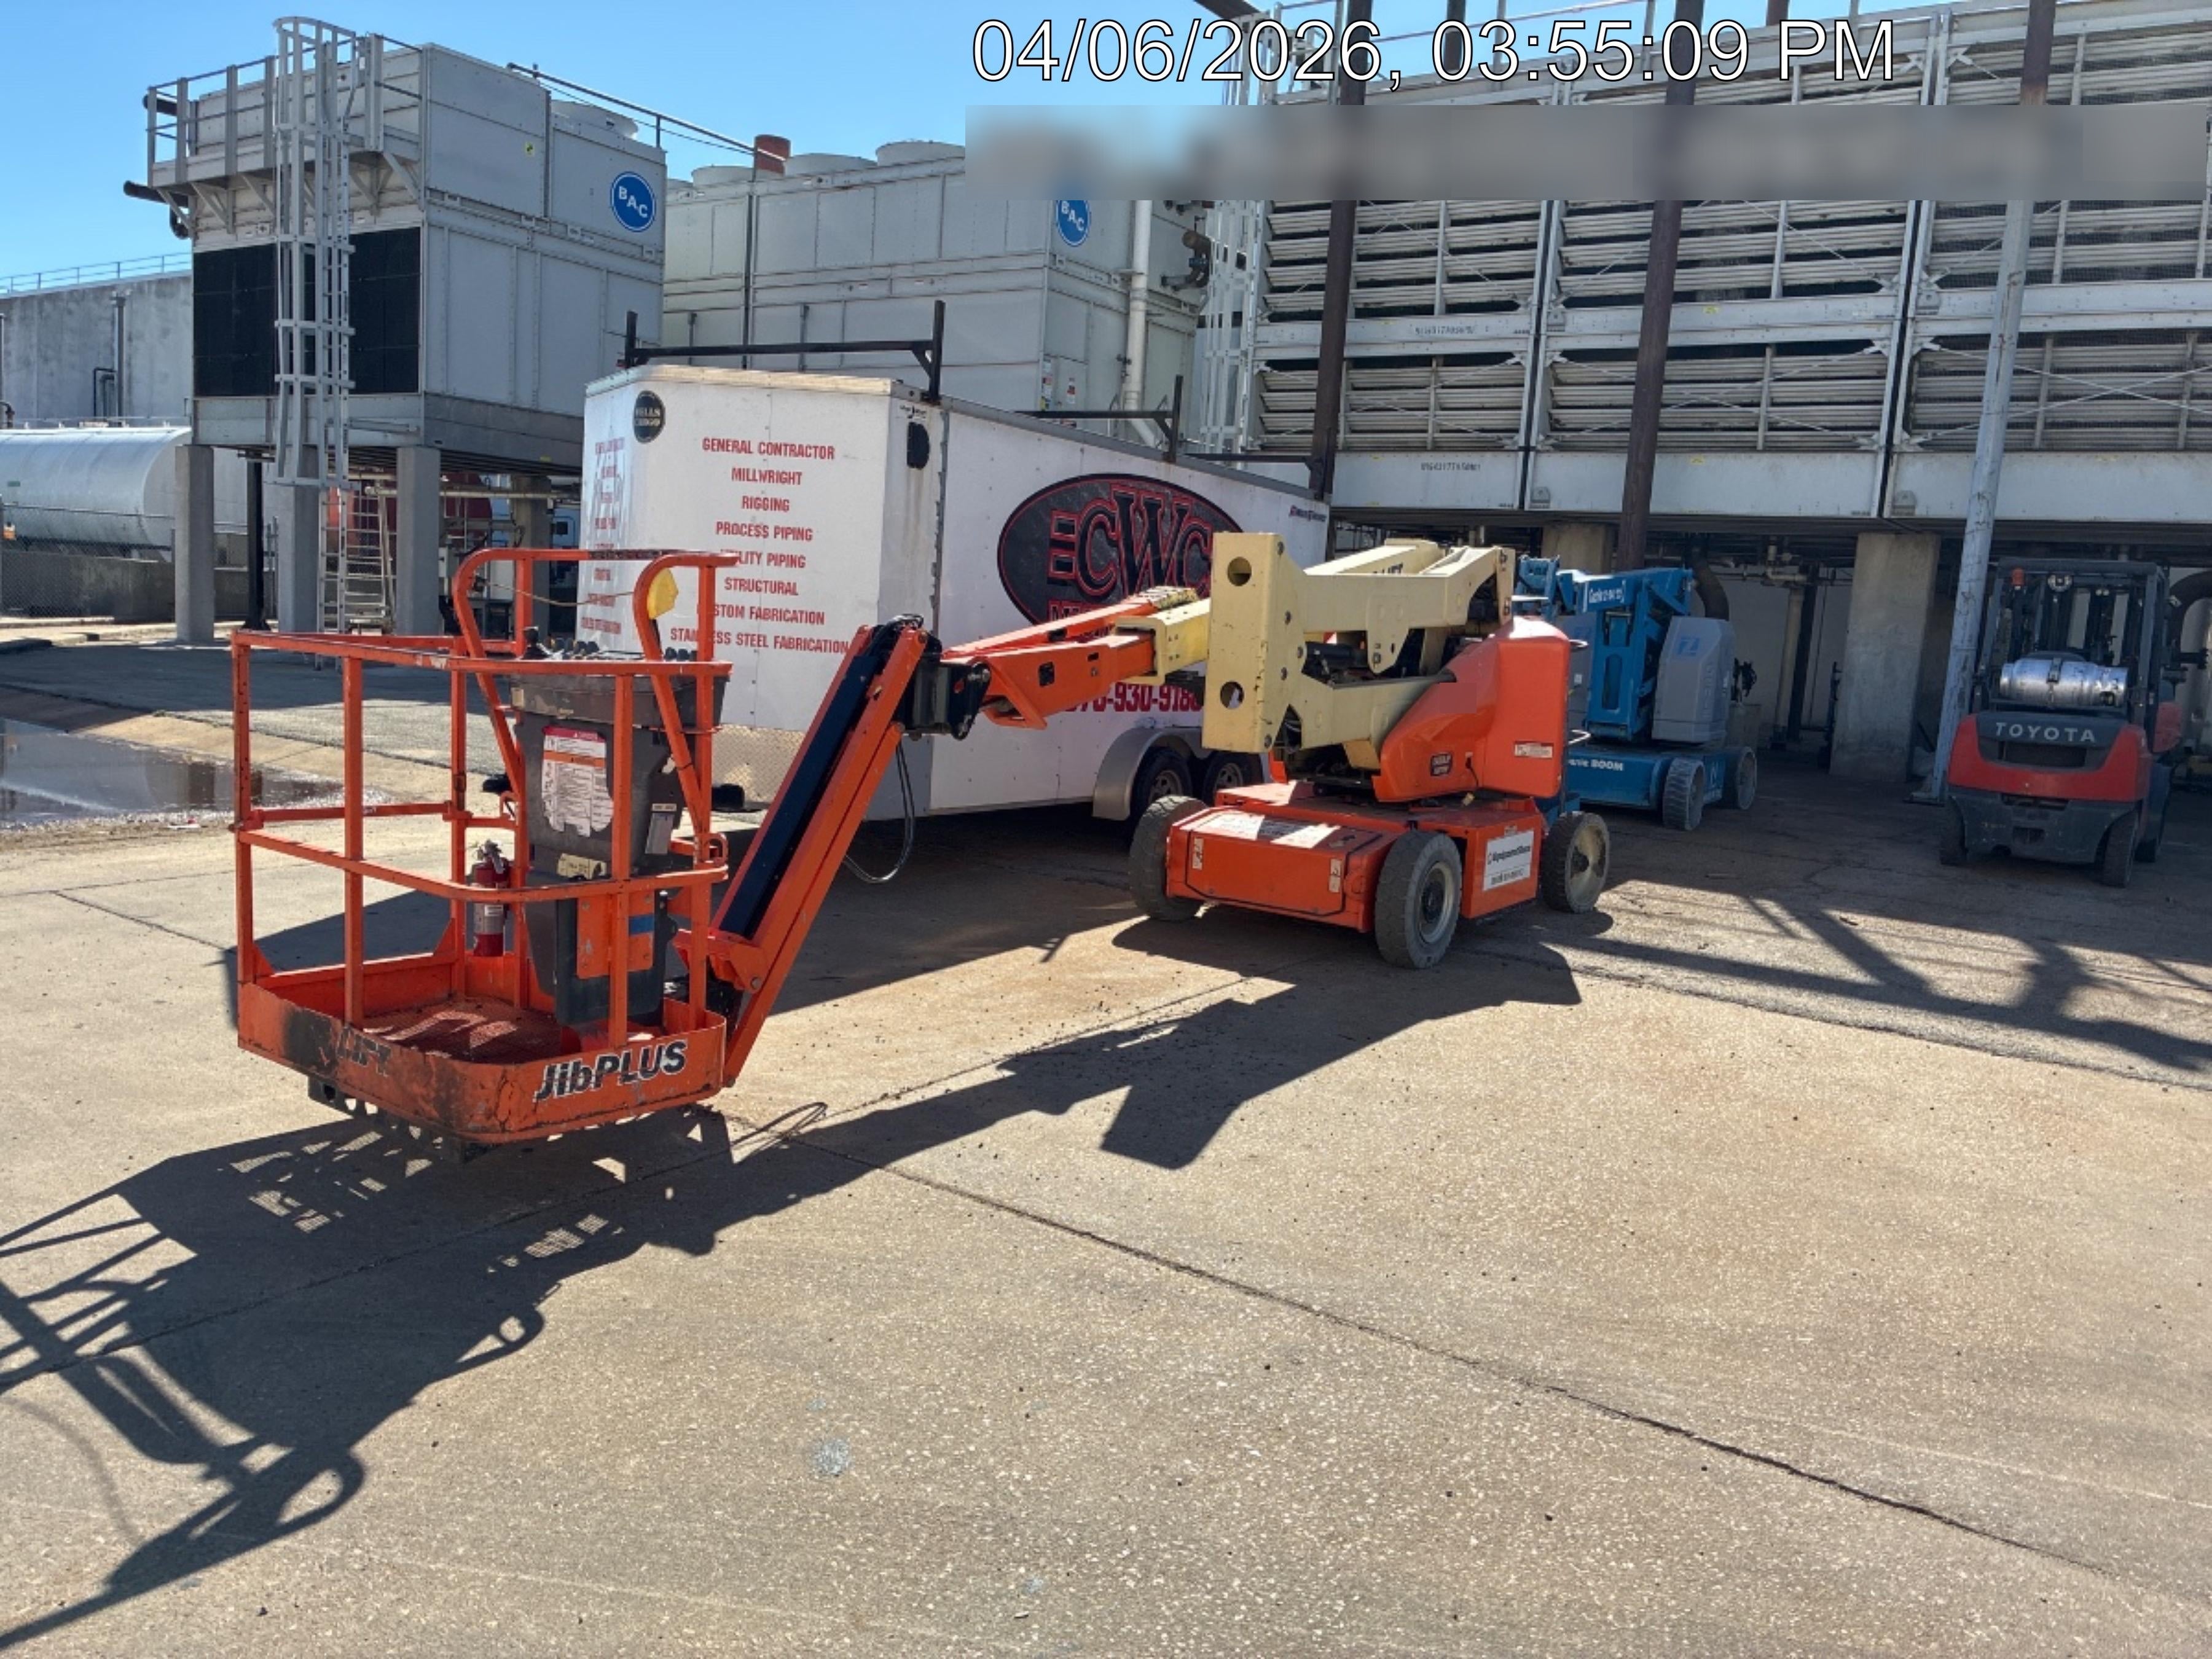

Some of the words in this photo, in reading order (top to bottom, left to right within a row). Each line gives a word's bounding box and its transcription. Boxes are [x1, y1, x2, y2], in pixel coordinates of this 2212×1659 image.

[618, 186, 648, 218] BAC
[1061, 200, 1085, 232] BAC
[702, 437, 753, 454] GENERAL
[758, 442, 836, 460] CONTRACTOR
[731, 468, 802, 485] MILLWRIGHT
[742, 495, 790, 512] RIGGING
[716, 521, 769, 539] PROCESS
[774, 525, 813, 542] PIPING
[720, 549, 763, 566] LITY
[767, 552, 807, 568] PIPING
[724, 576, 799, 596] STRUCTURAL
[698, 603, 745, 619] STOM
[750, 606, 825, 625] FABRICATION
[670, 627, 731, 645] STAIESS
[735, 632, 769, 648] STEEL
[774, 635, 849, 654] FABRICATION
[1995, 721, 2096, 742] TOYOTA
[533, 1038, 688, 1102] JibPLUS
